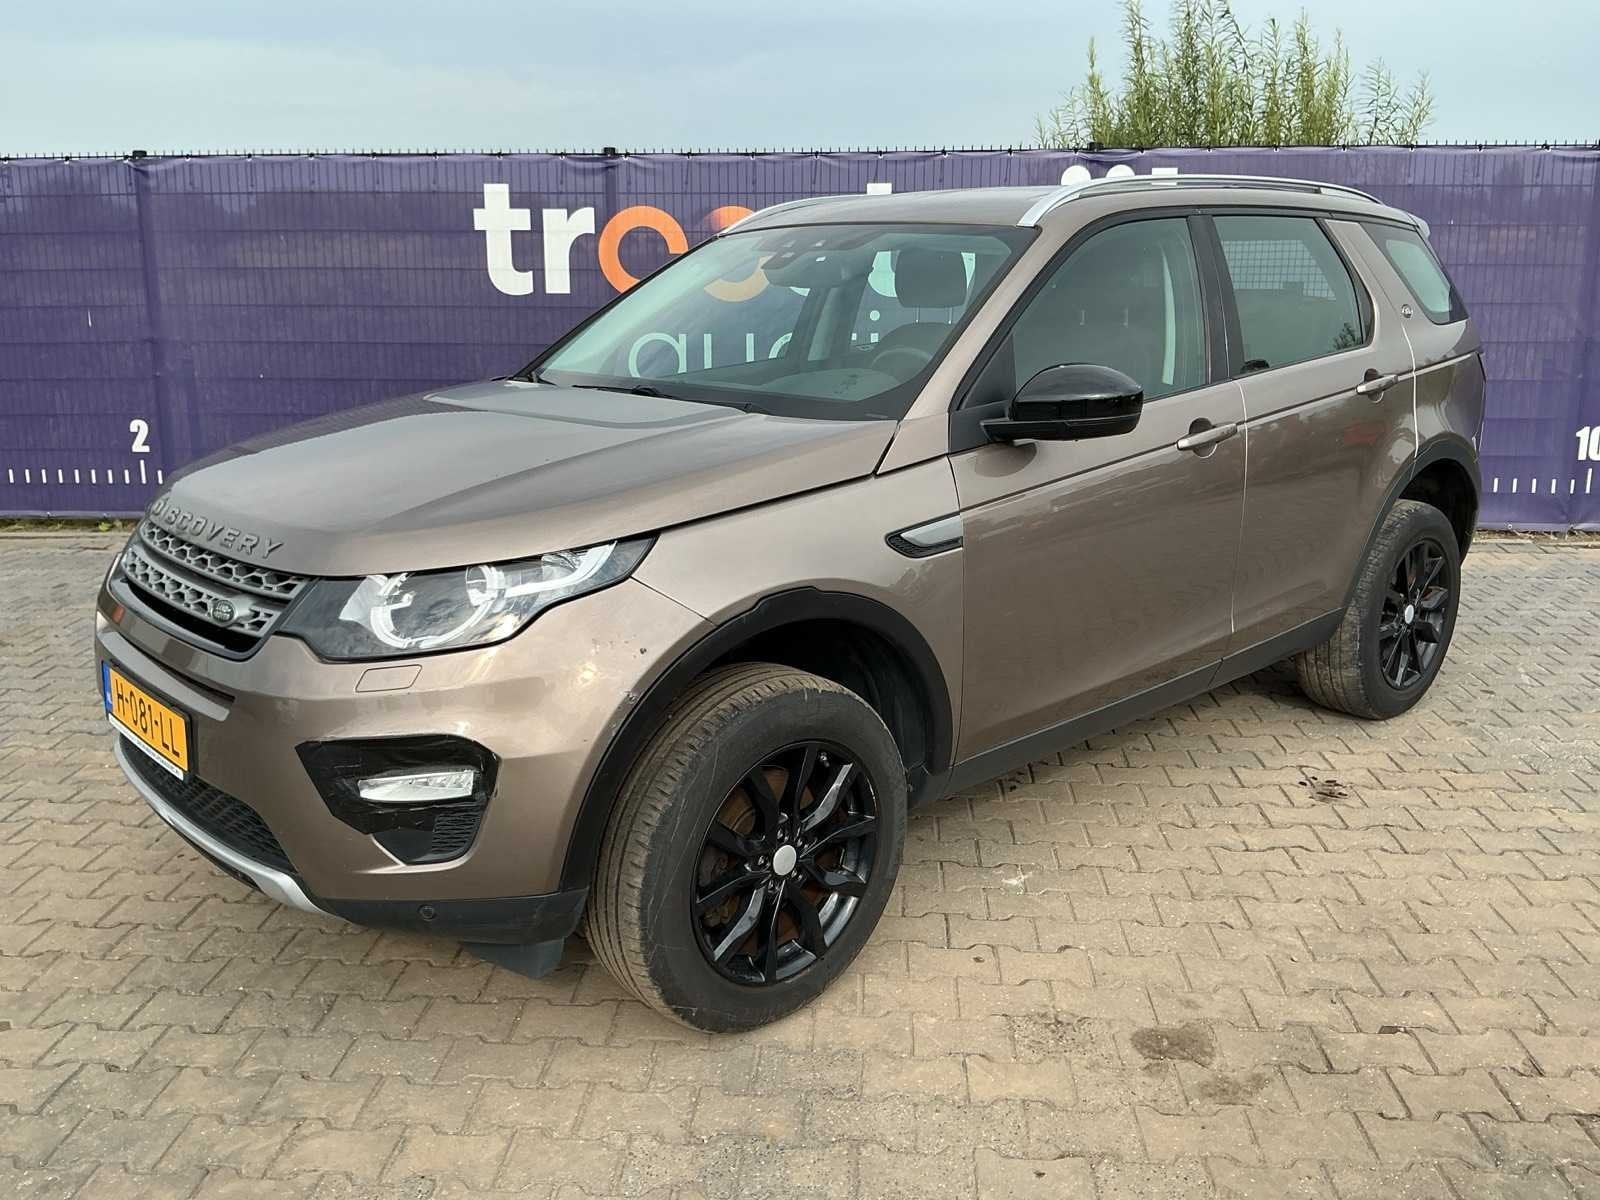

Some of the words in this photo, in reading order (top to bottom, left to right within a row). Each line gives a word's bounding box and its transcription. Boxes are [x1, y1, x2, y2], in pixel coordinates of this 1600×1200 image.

[129, 418, 151, 453] 2
[151, 498, 284, 559] DISCOVERY
[115, 679, 181, 758] H-081-LL
